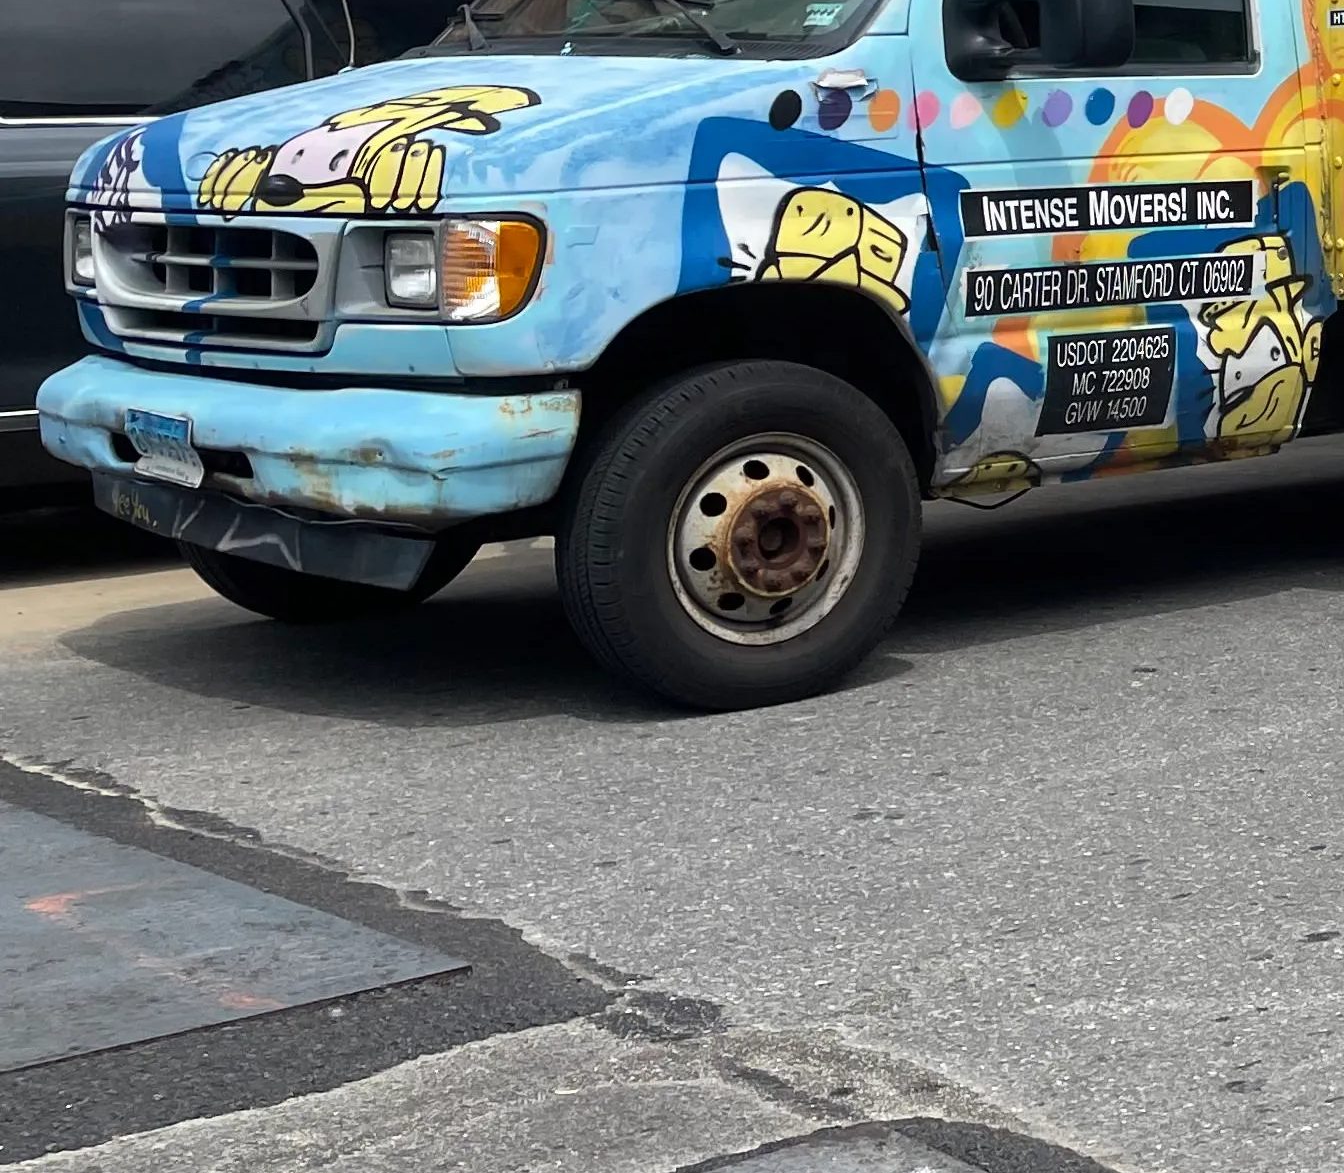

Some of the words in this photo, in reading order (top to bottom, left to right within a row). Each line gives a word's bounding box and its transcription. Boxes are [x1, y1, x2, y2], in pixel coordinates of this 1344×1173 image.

[982, 195, 1079, 232] INTENSE
[1088, 187, 1188, 227] MOVERS!
[1196, 189, 1235, 221] INC.
[974, 275, 995, 312] 90
[1000, 270, 1062, 310] CARTER
[1066, 268, 1090, 305] DR.
[1095, 262, 1174, 303] STAMFORD
[1179, 261, 1200, 297] CT
[1203, 259, 1246, 294] 06902
[1056, 339, 1107, 368] USDOT
[1111, 334, 1169, 363] 2204625
[1071, 371, 1097, 396] MC
[1101, 366, 1151, 393] 722908
[1065, 399, 1103, 425] GVW
[1105, 395, 1147, 422] 14,500
